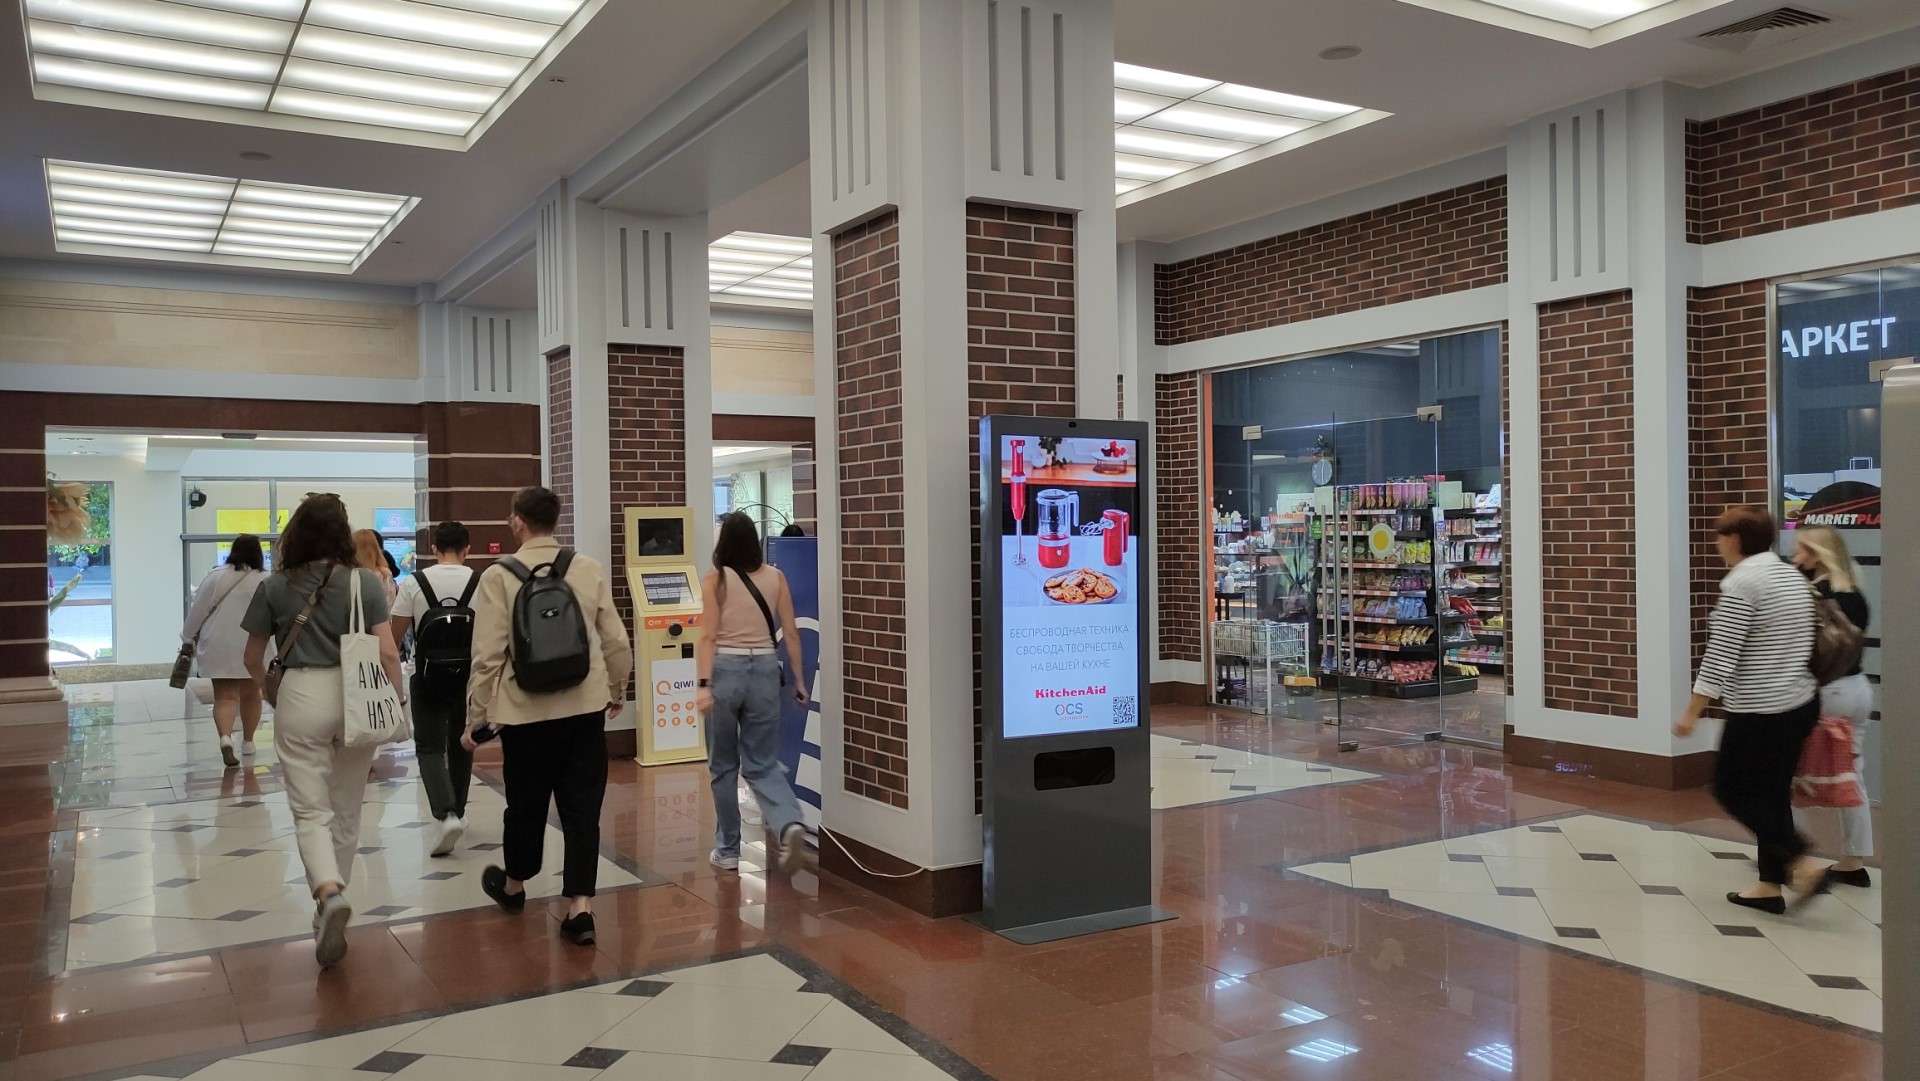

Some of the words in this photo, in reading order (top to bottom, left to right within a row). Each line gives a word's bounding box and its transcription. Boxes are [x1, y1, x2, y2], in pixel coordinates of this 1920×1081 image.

[1009, 626, 1087, 639] БЕСПРОВОДНАЯ
[1089, 624, 1130, 635] ТЕХНИКА
[1016, 644, 1064, 656] СВОБОДА
[1066, 641, 1124, 653] ТВОРЧЕСТВА
[1030, 662, 1046, 673] НА
[1046, 660, 1080, 672] ВАШЕЙ
[1082, 658, 1111, 670] КУХНЕ
[673, 680, 694, 690] QIWI
[1035, 685, 1107, 699] KitchenAid
[1055, 702, 1084, 716] OCS
